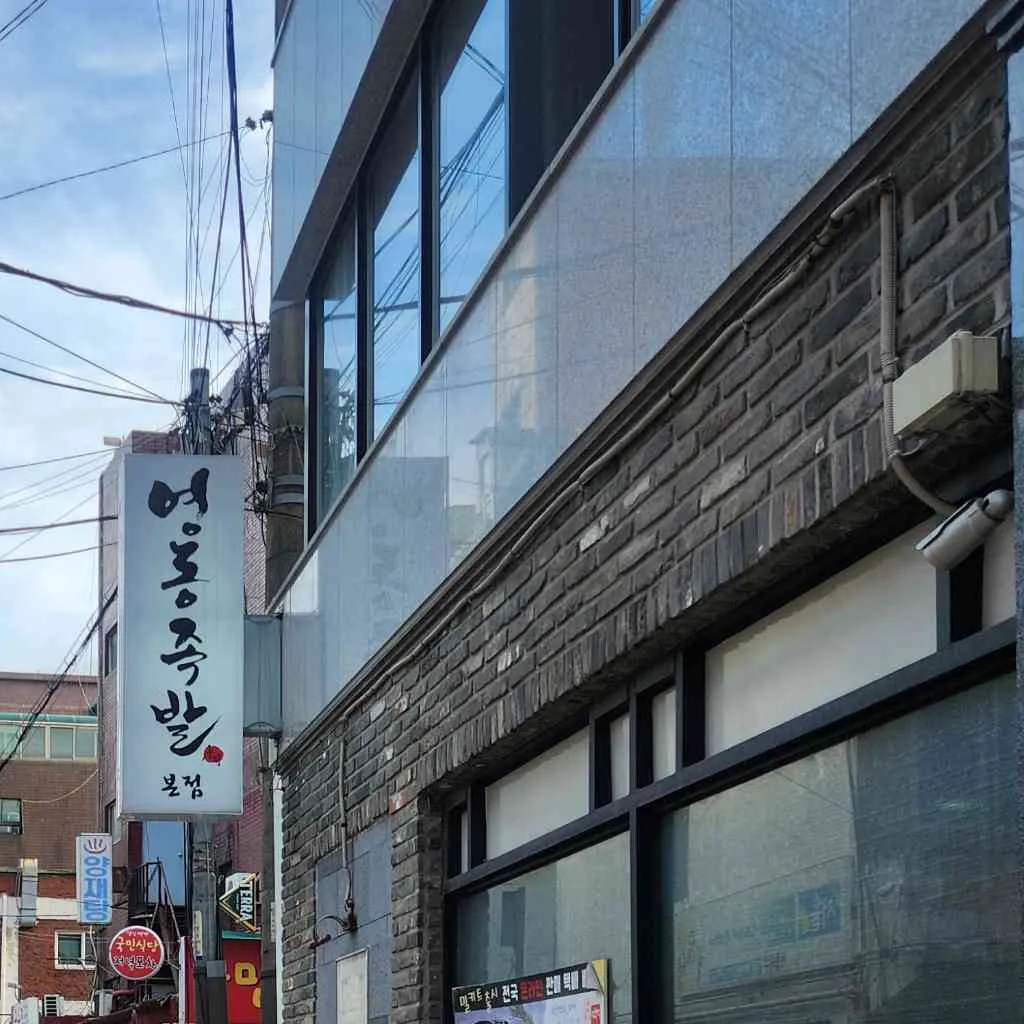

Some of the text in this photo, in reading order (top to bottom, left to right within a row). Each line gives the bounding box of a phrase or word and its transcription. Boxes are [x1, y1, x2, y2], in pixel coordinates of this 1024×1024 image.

[148, 467, 223, 757] 영동족발
[161, 773, 204, 800] 본점
[239, 880, 254, 921] TERRA
[115, 936, 160, 953] 국민식당
